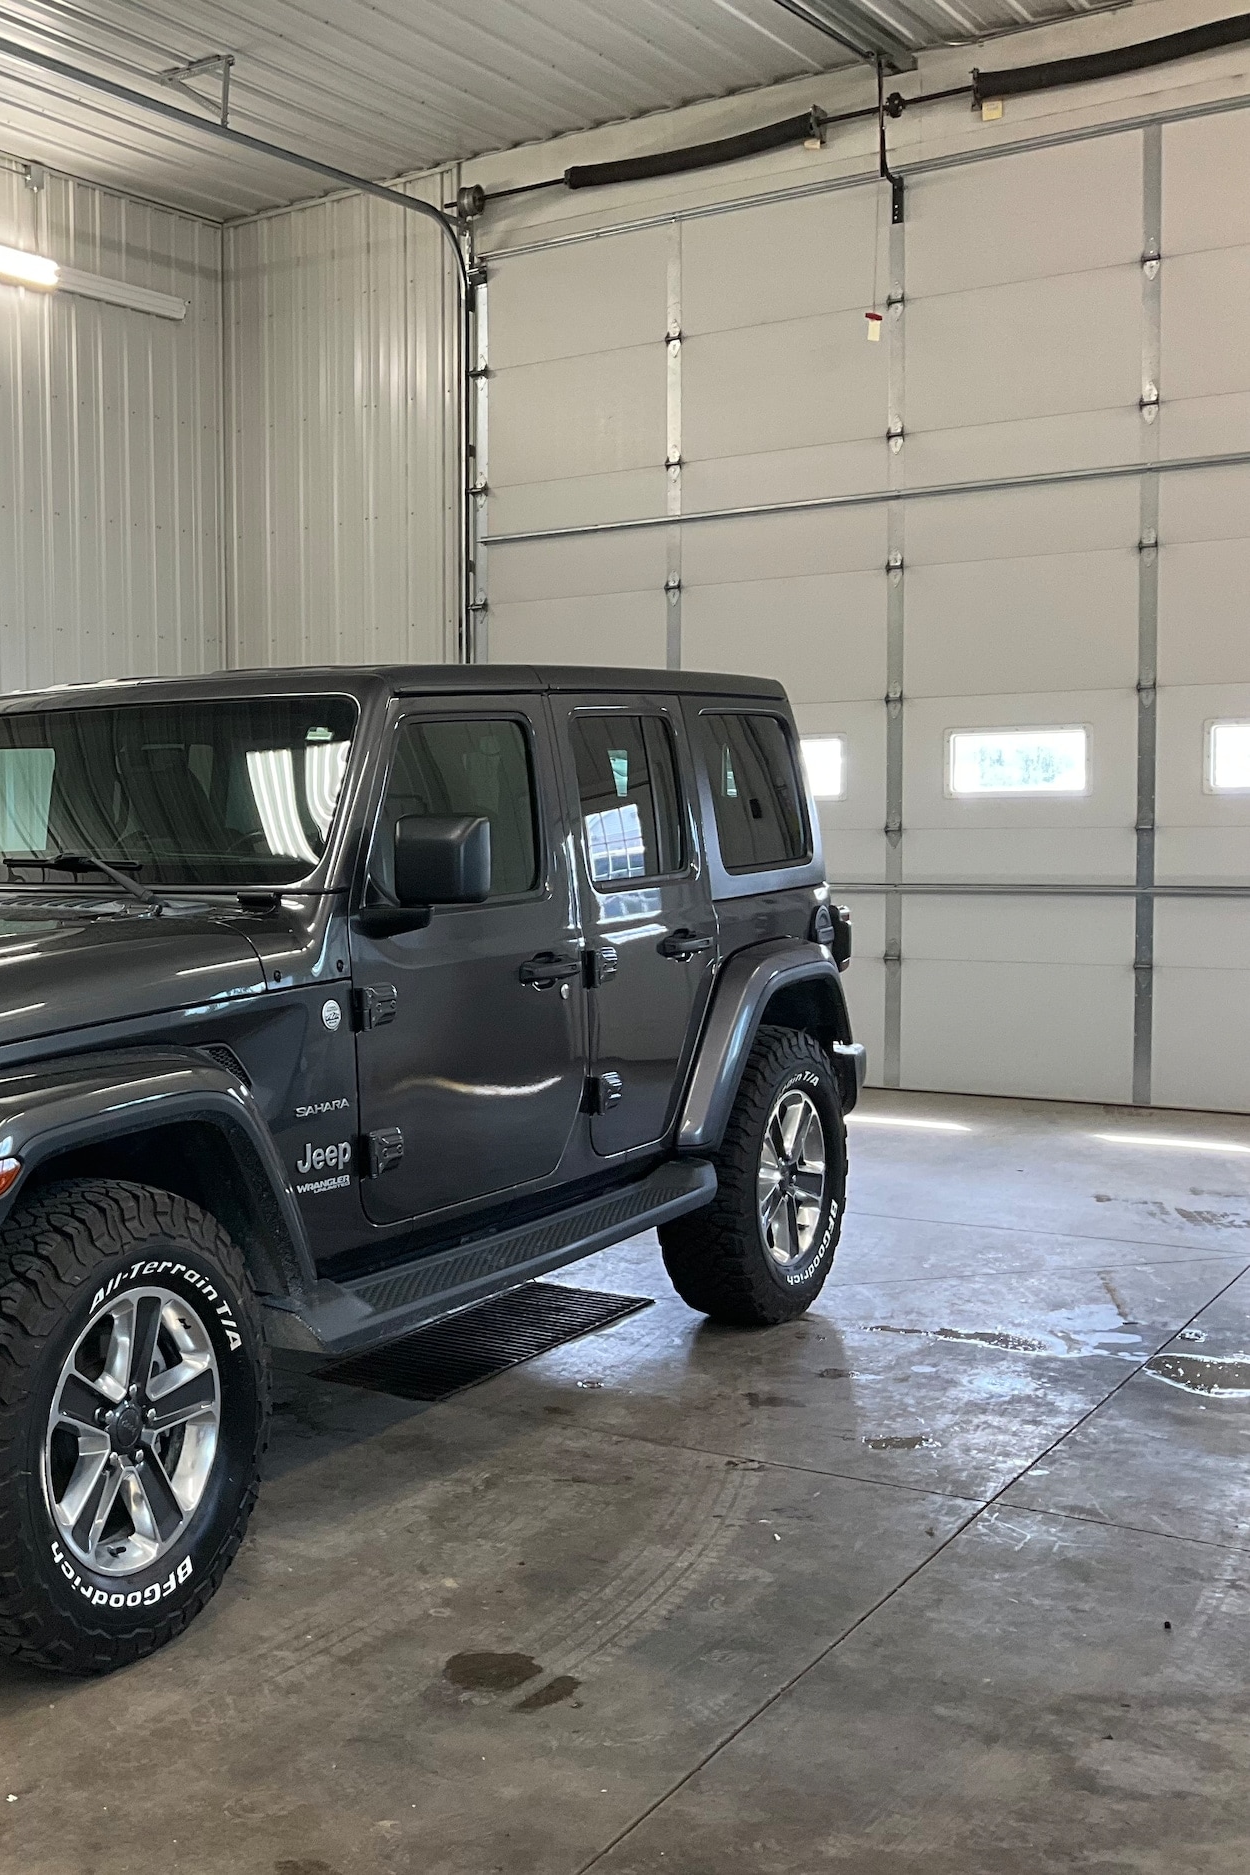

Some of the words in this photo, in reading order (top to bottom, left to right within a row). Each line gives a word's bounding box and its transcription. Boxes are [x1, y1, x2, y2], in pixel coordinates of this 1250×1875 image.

[295, 1098, 350, 1117] SAHARA
[297, 1141, 352, 1173] Jeep
[296, 1174, 350, 1193] WRANGLER
[786, 1199, 838, 1286] BFGoodrich
[89, 1261, 219, 1315] All-Terrain
[216, 1300, 242, 1351] T/A
[51, 1541, 193, 1608] BFGoodrich
